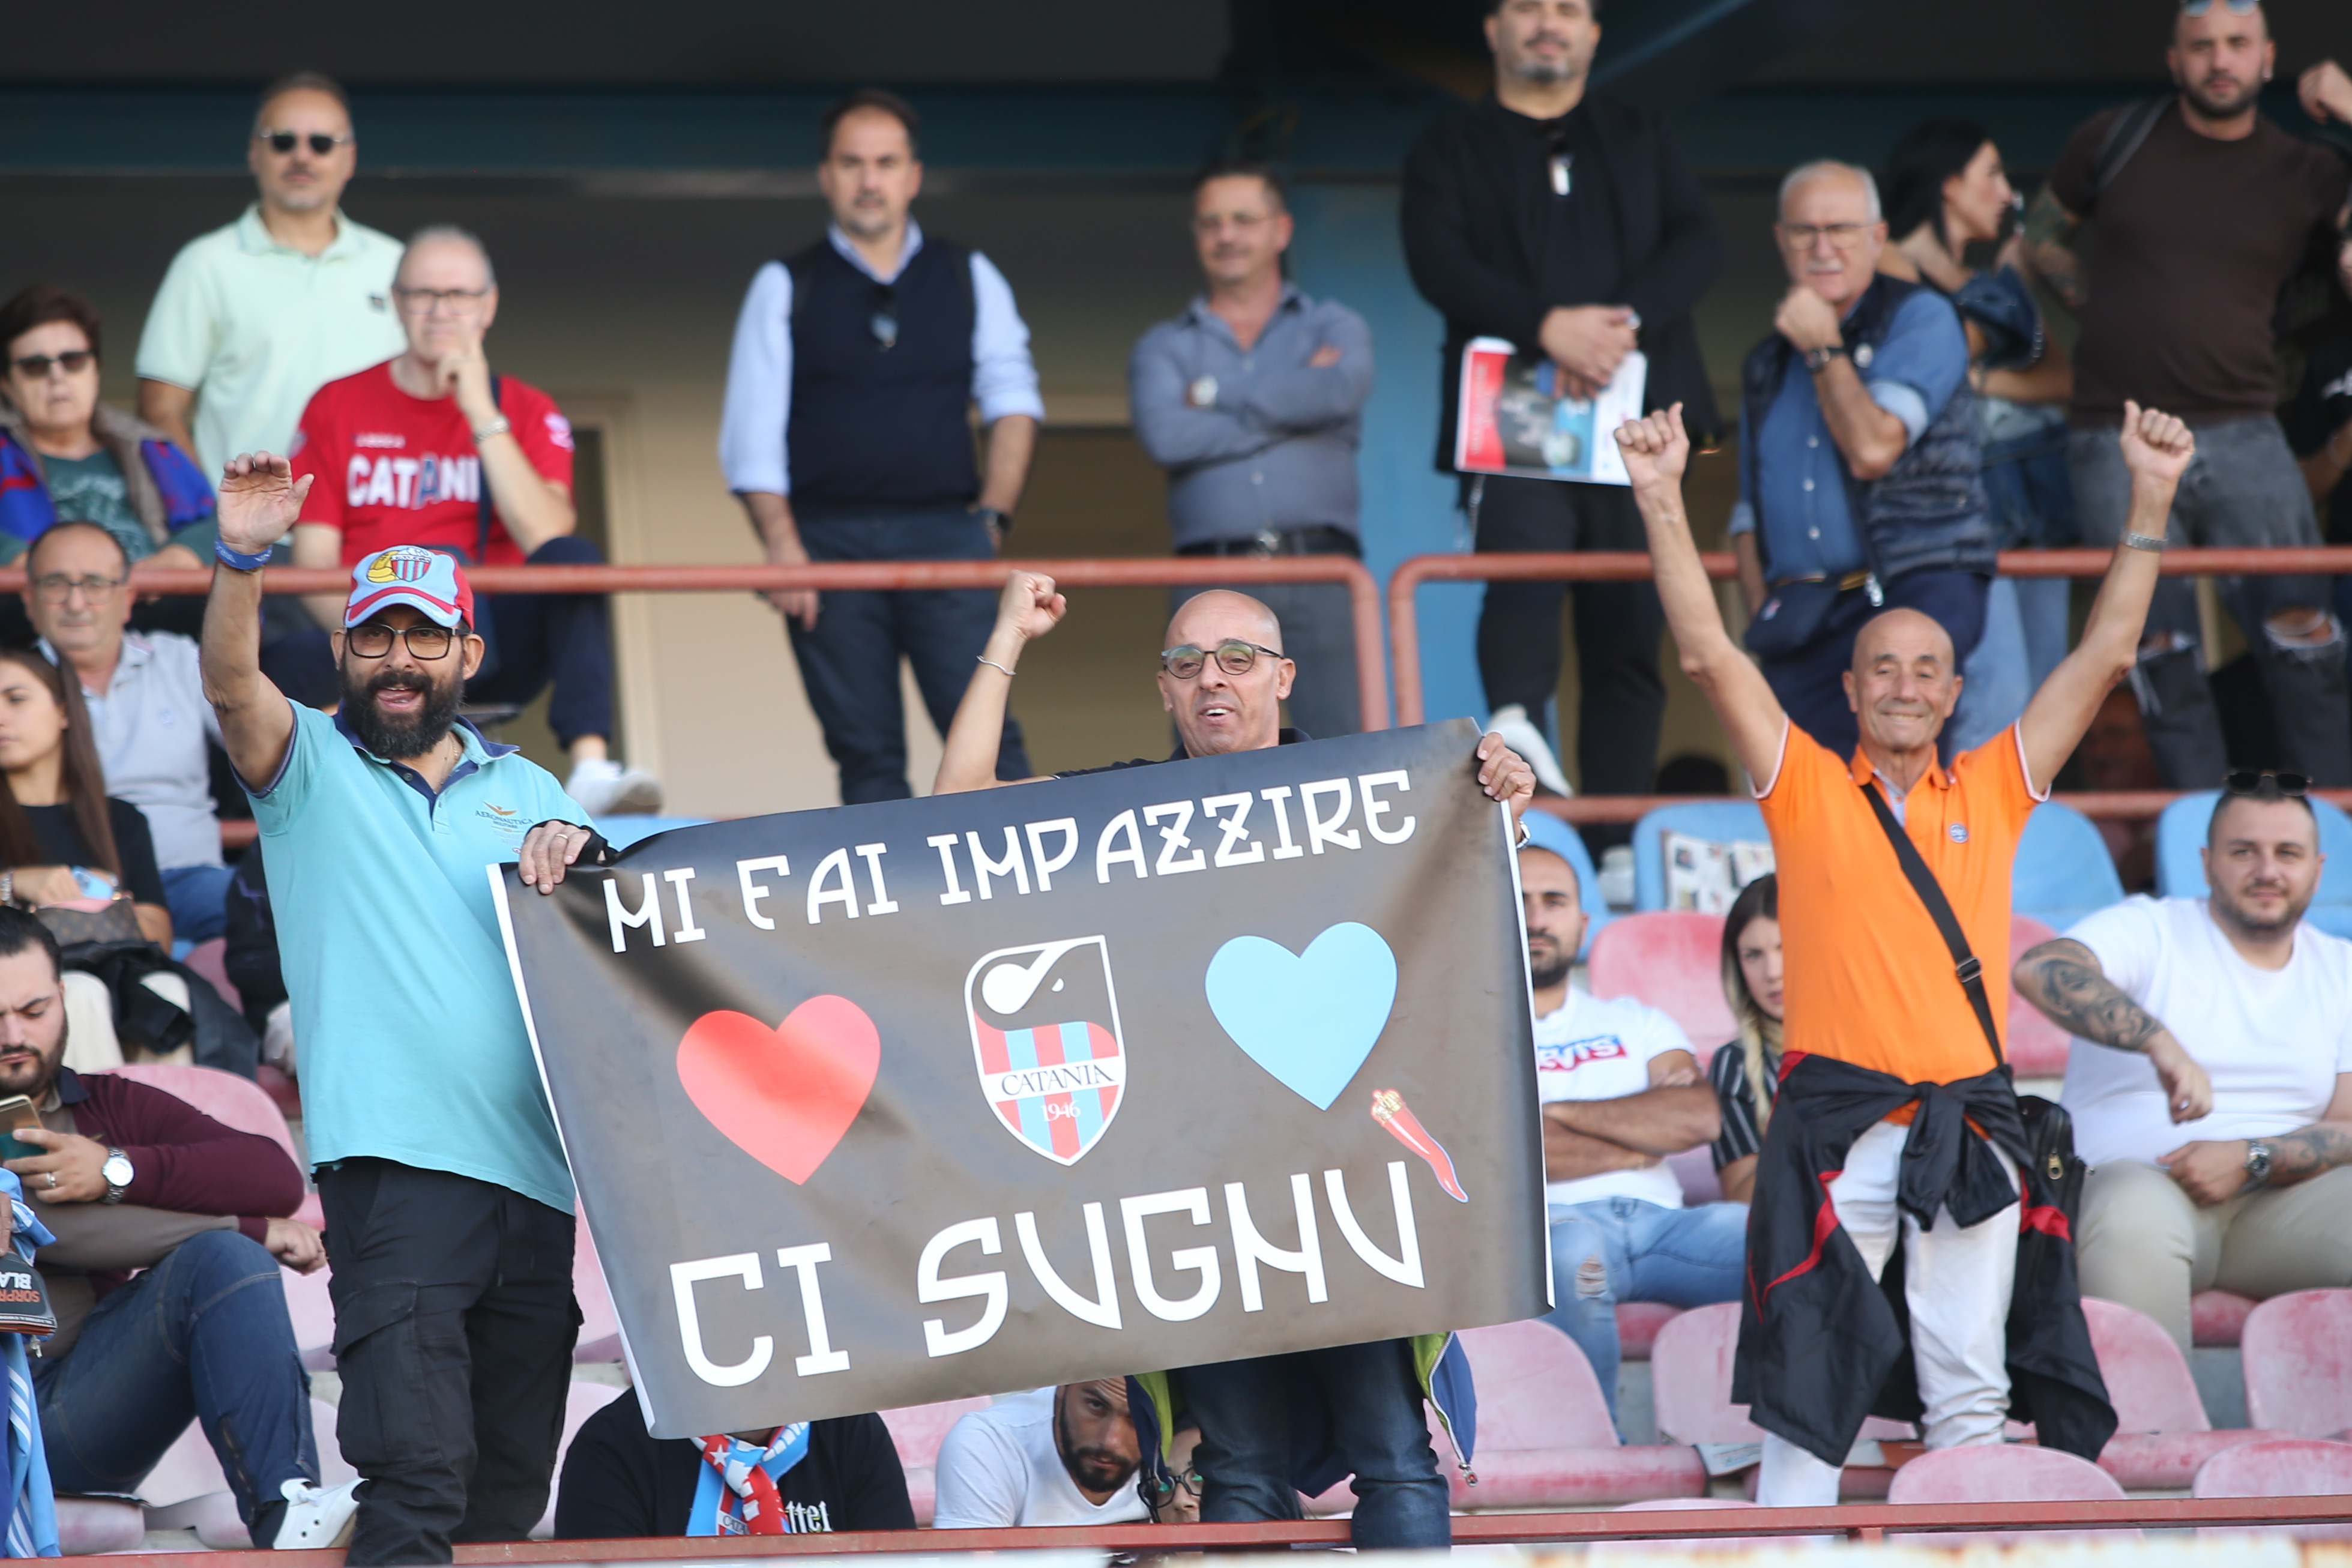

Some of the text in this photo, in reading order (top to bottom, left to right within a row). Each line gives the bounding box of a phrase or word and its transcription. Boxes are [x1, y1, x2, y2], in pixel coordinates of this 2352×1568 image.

[347, 454, 480, 509] CATANI
[602, 867, 707, 953] MI
[926, 769, 1417, 905] IMPAZZIRE
[1001, 1064, 1116, 1096] CATANIA
[1040, 1100, 1081, 1122] 1946
[669, 1241, 851, 1387] CI
